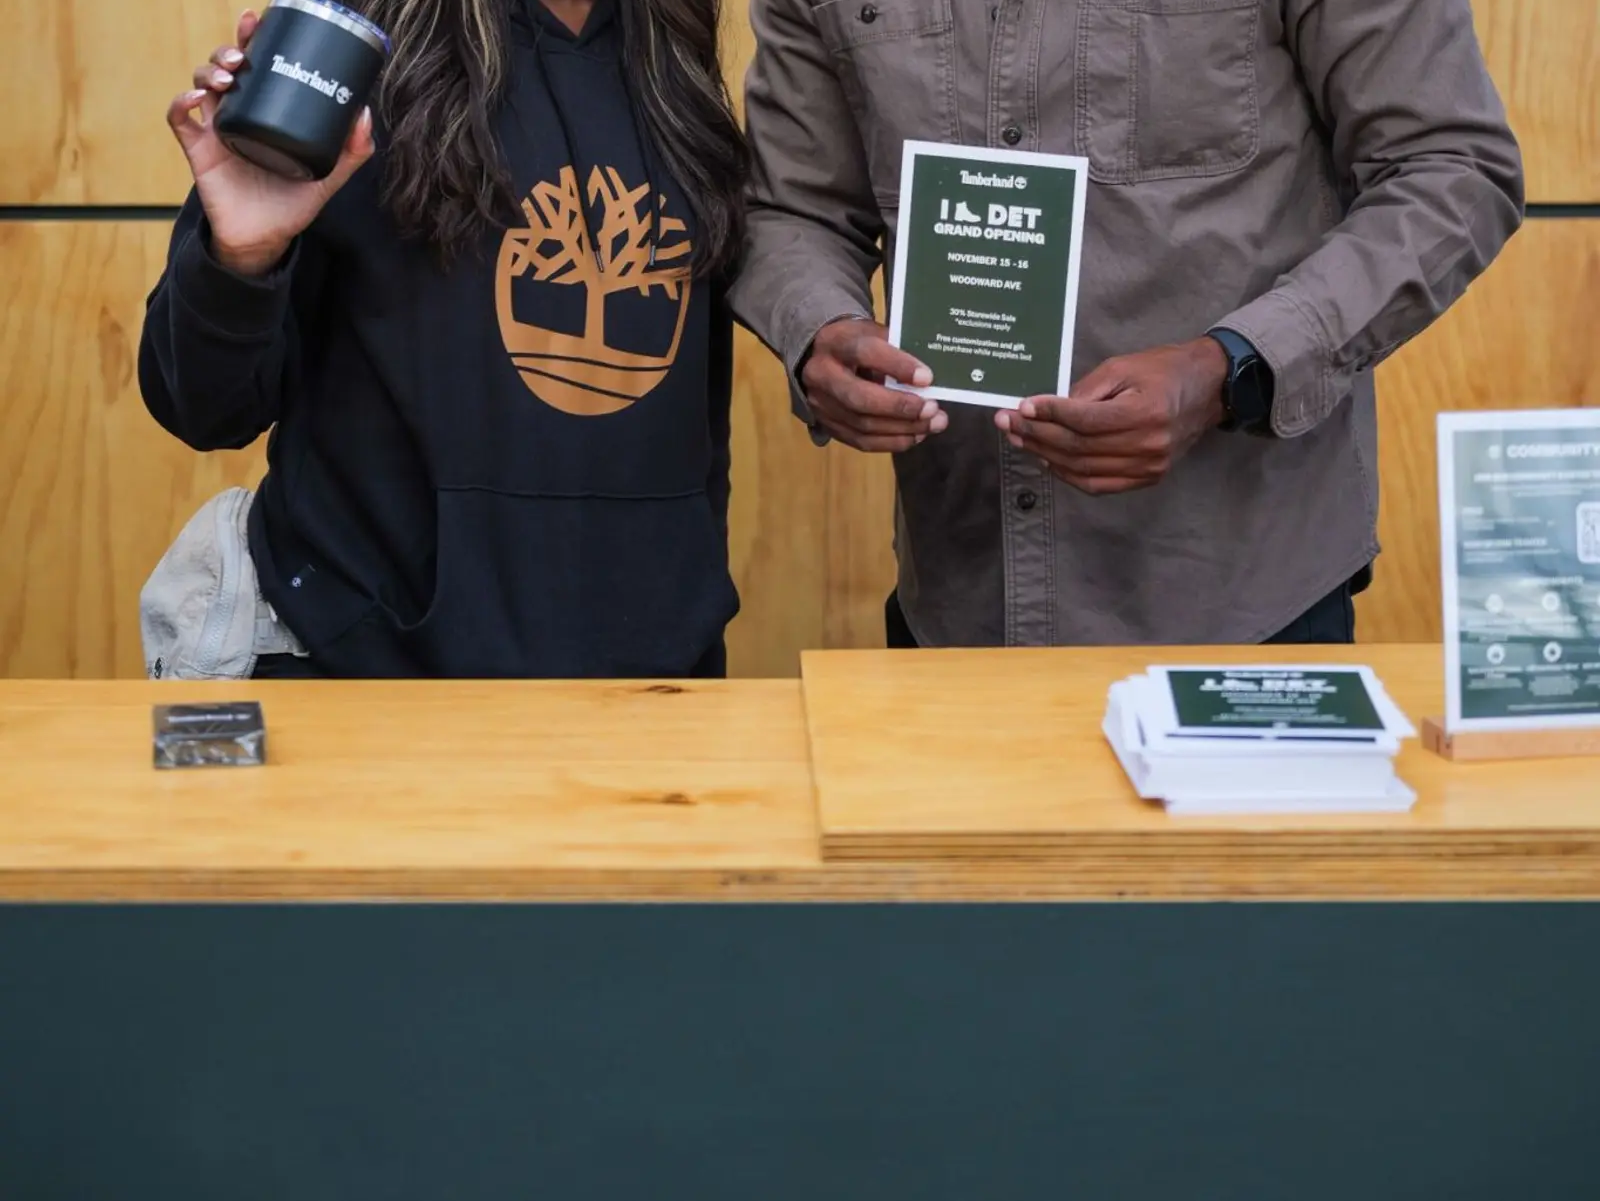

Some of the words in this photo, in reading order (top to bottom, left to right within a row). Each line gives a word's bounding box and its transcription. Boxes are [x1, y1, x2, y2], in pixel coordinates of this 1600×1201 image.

[271, 54, 340, 97] Timberland
[960, 170, 1014, 188] Timberland
[940, 199, 949, 220] I
[988, 204, 1042, 229] DET
[934, 222, 982, 238] GRAND
[984, 227, 1045, 245] OPENING
[948, 252, 998, 266] NOVEMBER
[999, 258, 1011, 267] 15
[949, 274, 1003, 288] WOODWARD
[1003, 280, 1022, 290] AVE
[967, 309, 1000, 321] Storewide
[1001, 313, 1016, 323] Sale
[993, 323, 1011, 332] apply
[936, 333, 951, 343] Free
[952, 335, 999, 348] customization
[1000, 340, 1013, 350] and
[1013, 343, 1025, 352] gift
[927, 342, 942, 351] with
[942, 344, 973, 355] purchase
[973, 347, 991, 357] while
[991, 350, 1019, 360] supplies
[1019, 352, 1032, 362] last
